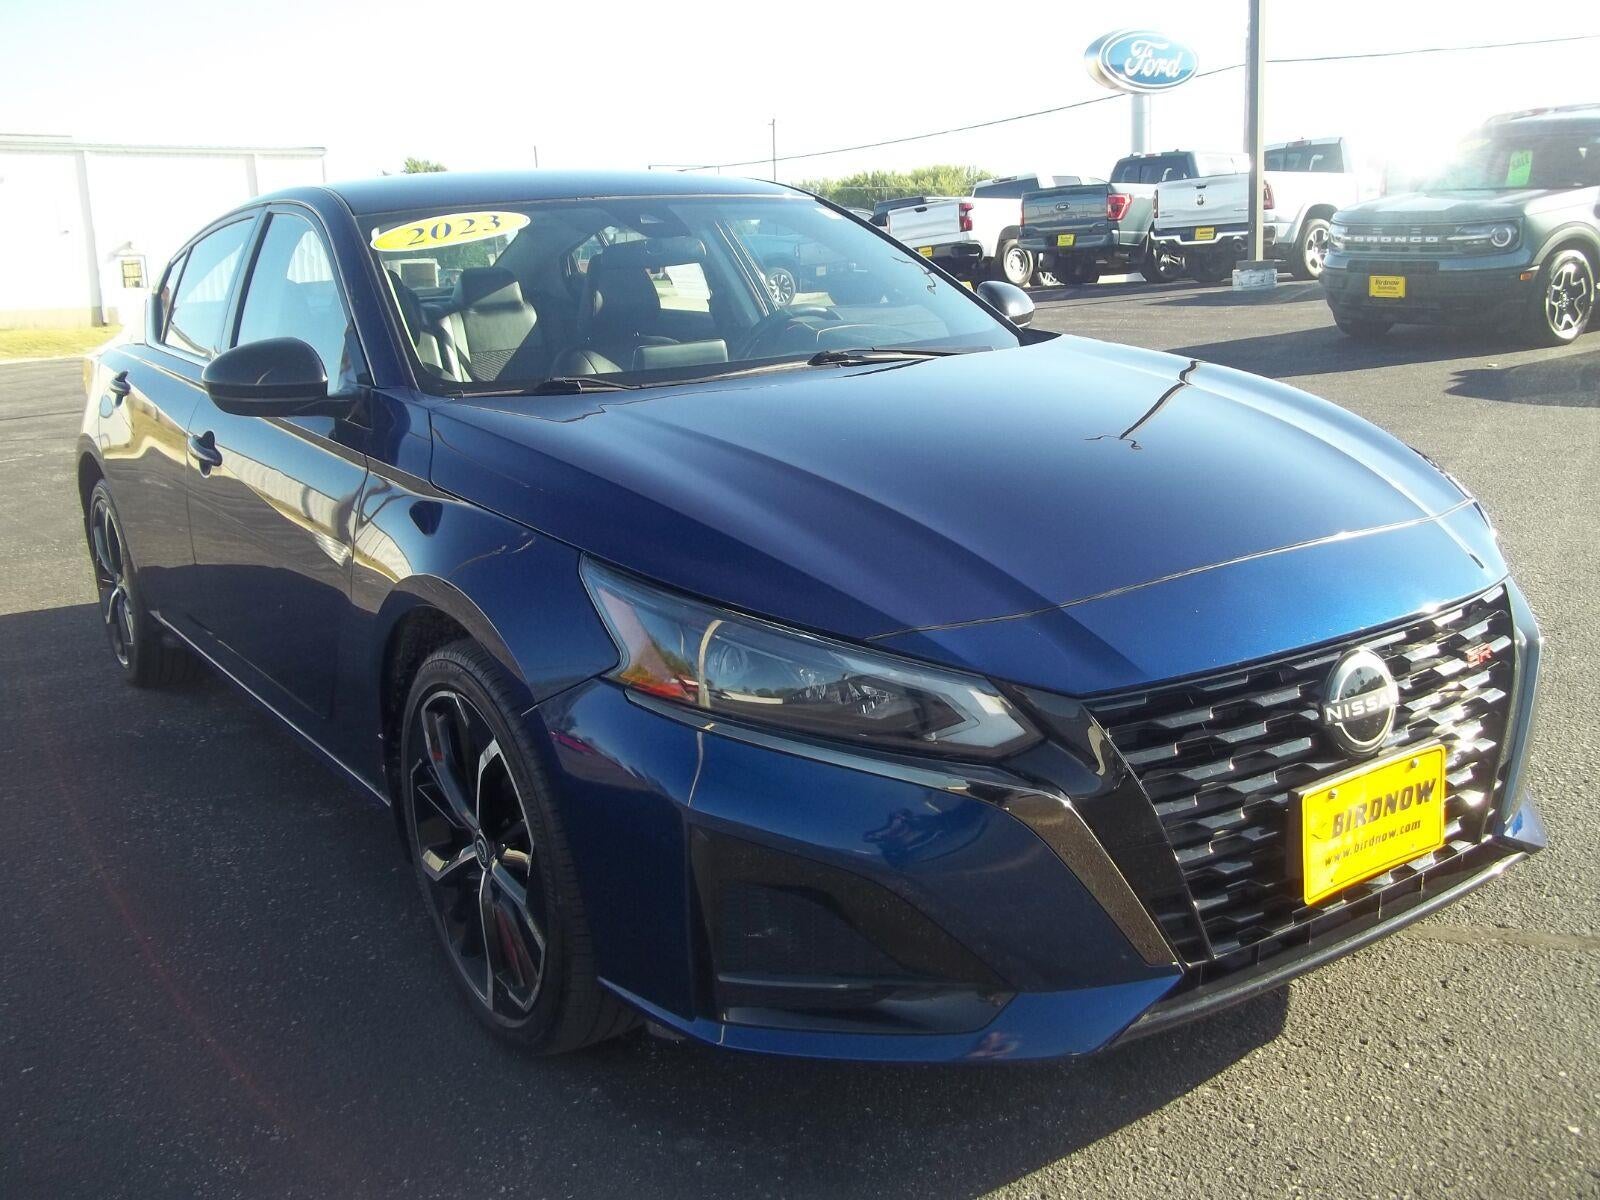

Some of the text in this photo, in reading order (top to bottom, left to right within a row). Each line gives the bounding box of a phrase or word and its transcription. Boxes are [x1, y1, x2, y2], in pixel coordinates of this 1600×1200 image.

[1124, 39, 1183, 77] Ford
[408, 215, 501, 245] 2023
[1354, 235, 1439, 243] BRONCO
[1325, 685, 1397, 721] NISSA
[1331, 778, 1437, 839] BIRDNOW
[1325, 820, 1421, 866] www.birdnow.com
